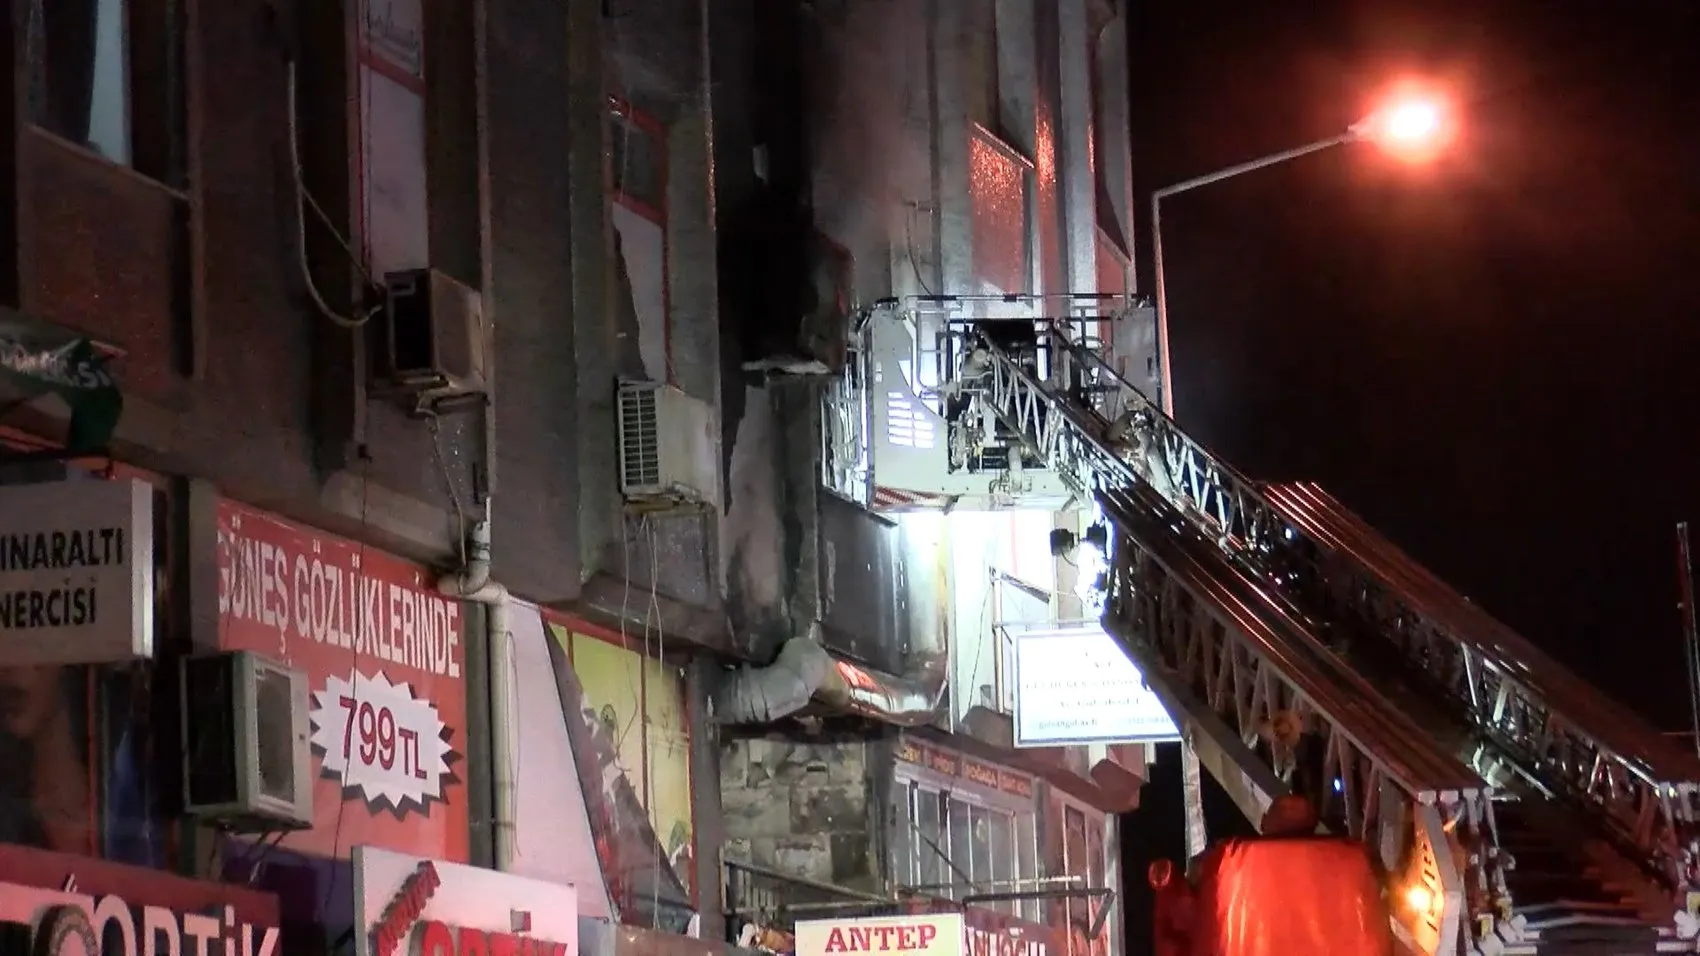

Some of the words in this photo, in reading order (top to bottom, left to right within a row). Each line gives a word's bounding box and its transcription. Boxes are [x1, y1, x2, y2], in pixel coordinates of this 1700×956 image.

[217, 514, 289, 655] GÜNEŞ
[294, 538, 461, 679] GÖZLÜKLERİNDE
[339, 696, 396, 771] 799
[824, 924, 937, 953] ANTEP
